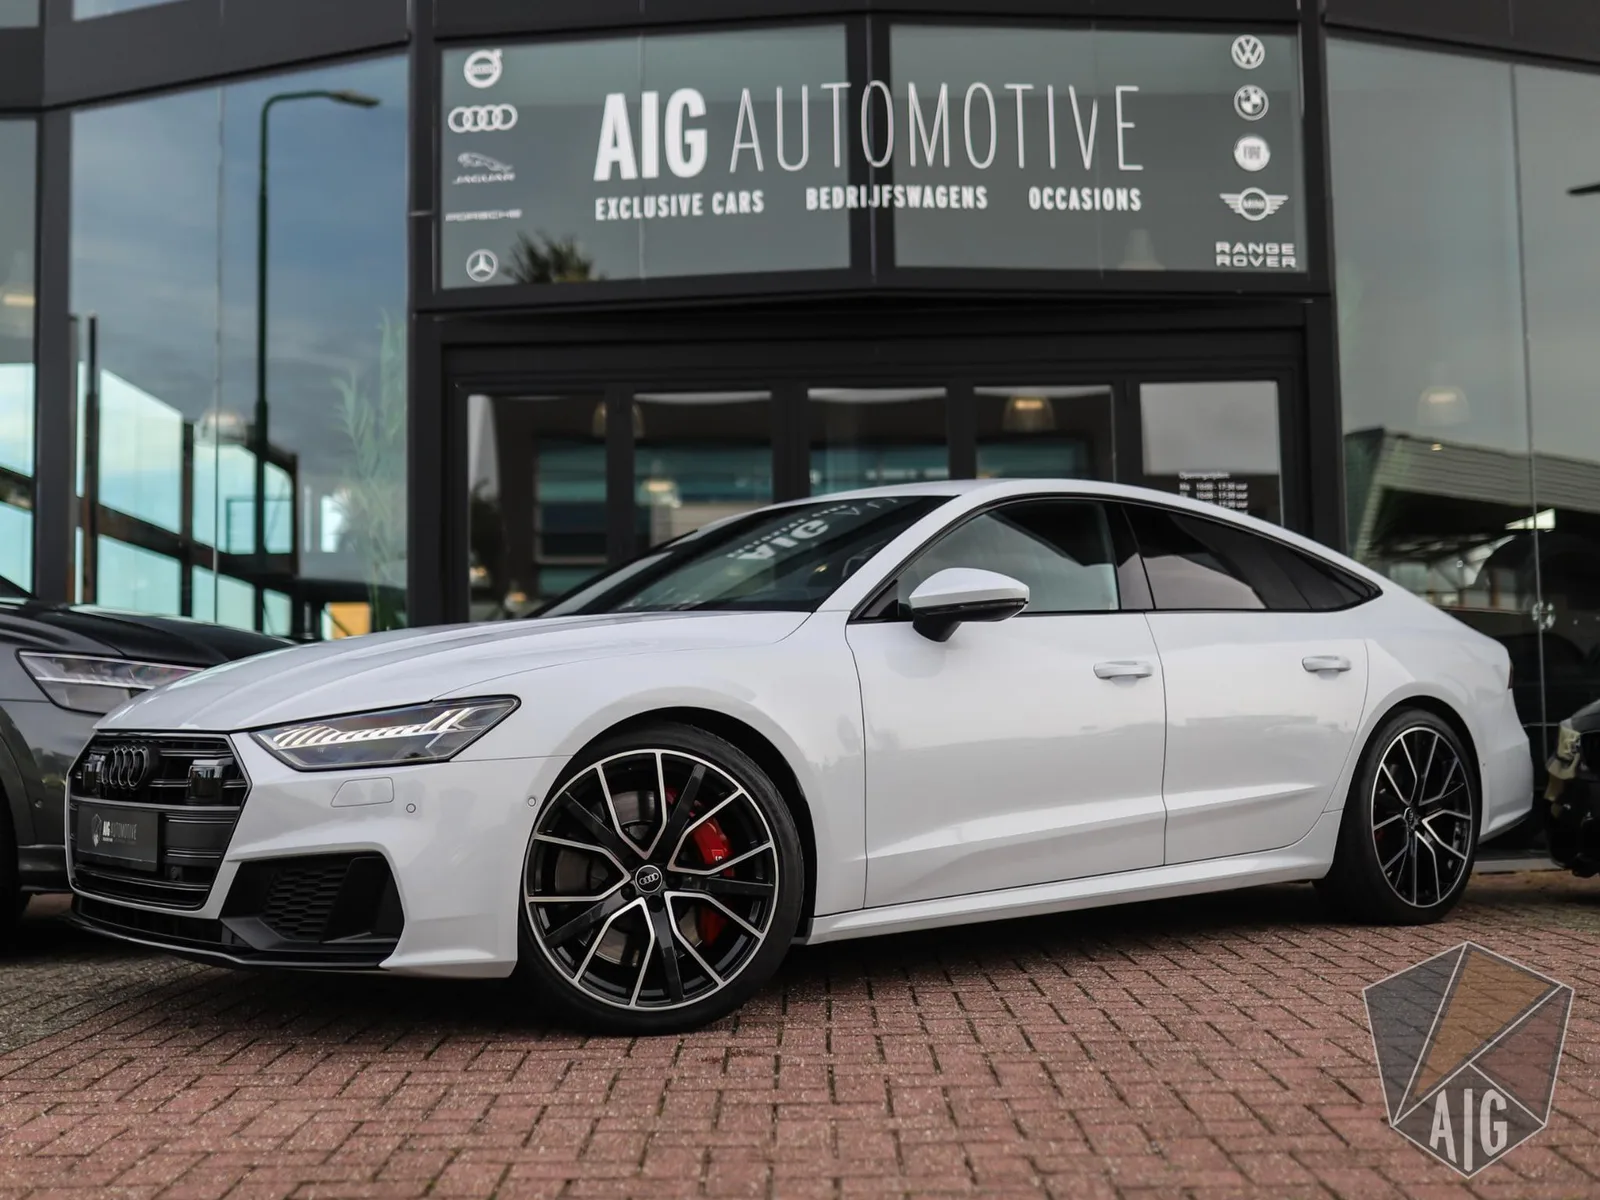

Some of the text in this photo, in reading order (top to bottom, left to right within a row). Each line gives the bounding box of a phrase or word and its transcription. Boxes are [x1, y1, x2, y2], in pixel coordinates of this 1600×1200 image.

[593, 80, 1144, 181] AIG AUTOMOTIVE
[595, 184, 1142, 221] EXCLUSIVE CARS BEDRIJFSWAGENS OCCASIONS
[1215, 241, 1295, 255] RANGE
[1216, 254, 1296, 268] ROVER
